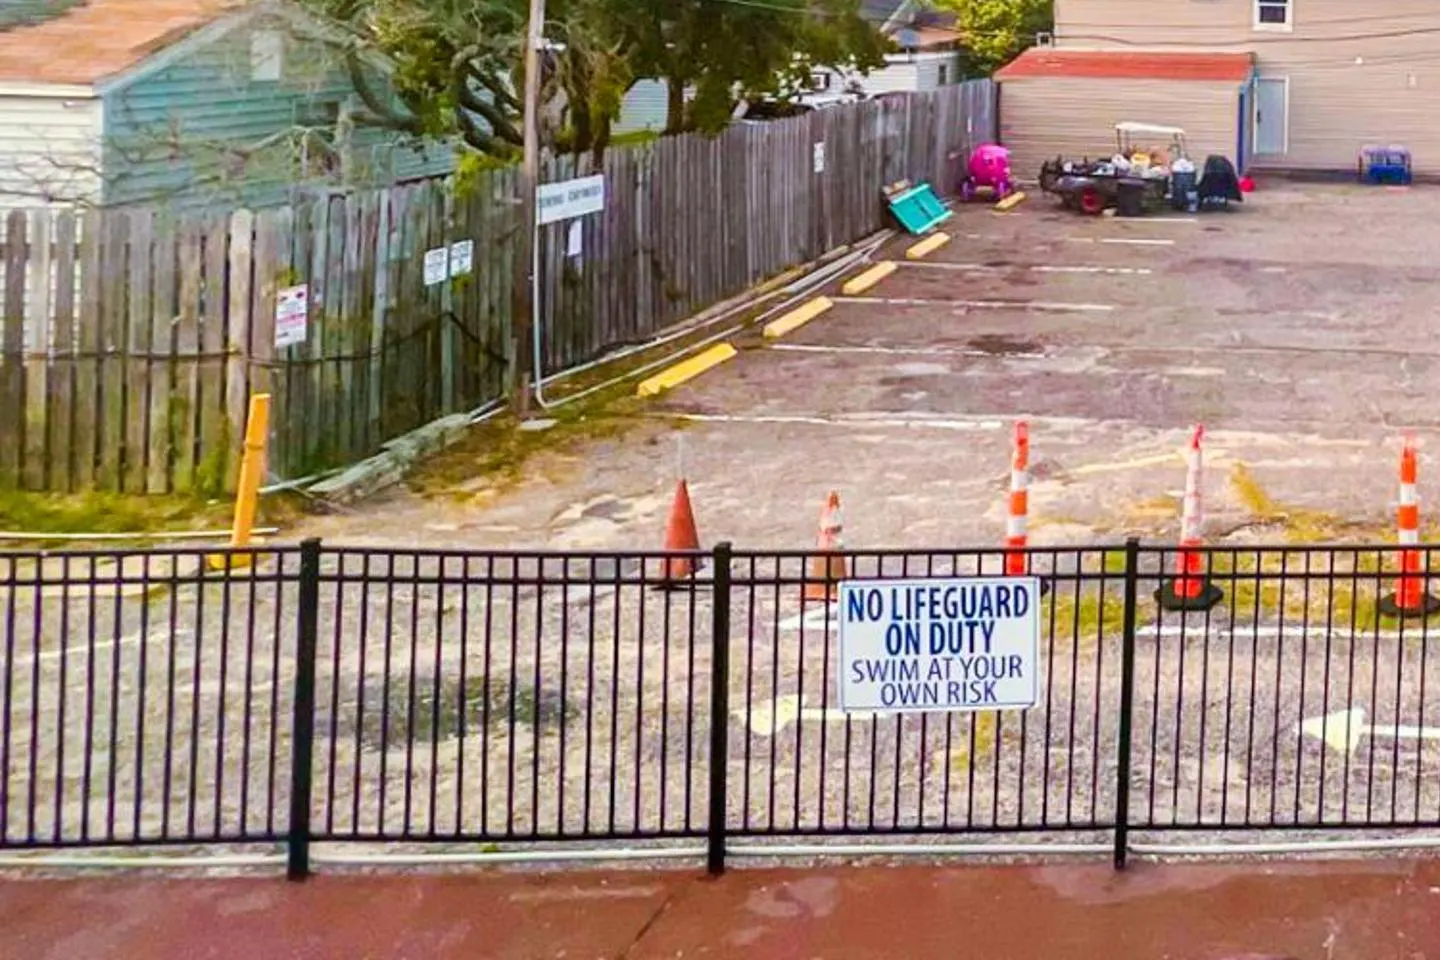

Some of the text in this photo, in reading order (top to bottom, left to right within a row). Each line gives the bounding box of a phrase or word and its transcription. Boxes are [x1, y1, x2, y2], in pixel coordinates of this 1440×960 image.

[847, 585, 1029, 622] NO LIFEGUARD
[886, 620, 995, 656] ON DUTY
[852, 655, 1023, 683] SWIM AT YOUR
[881, 680, 997, 706] OWN RISK
